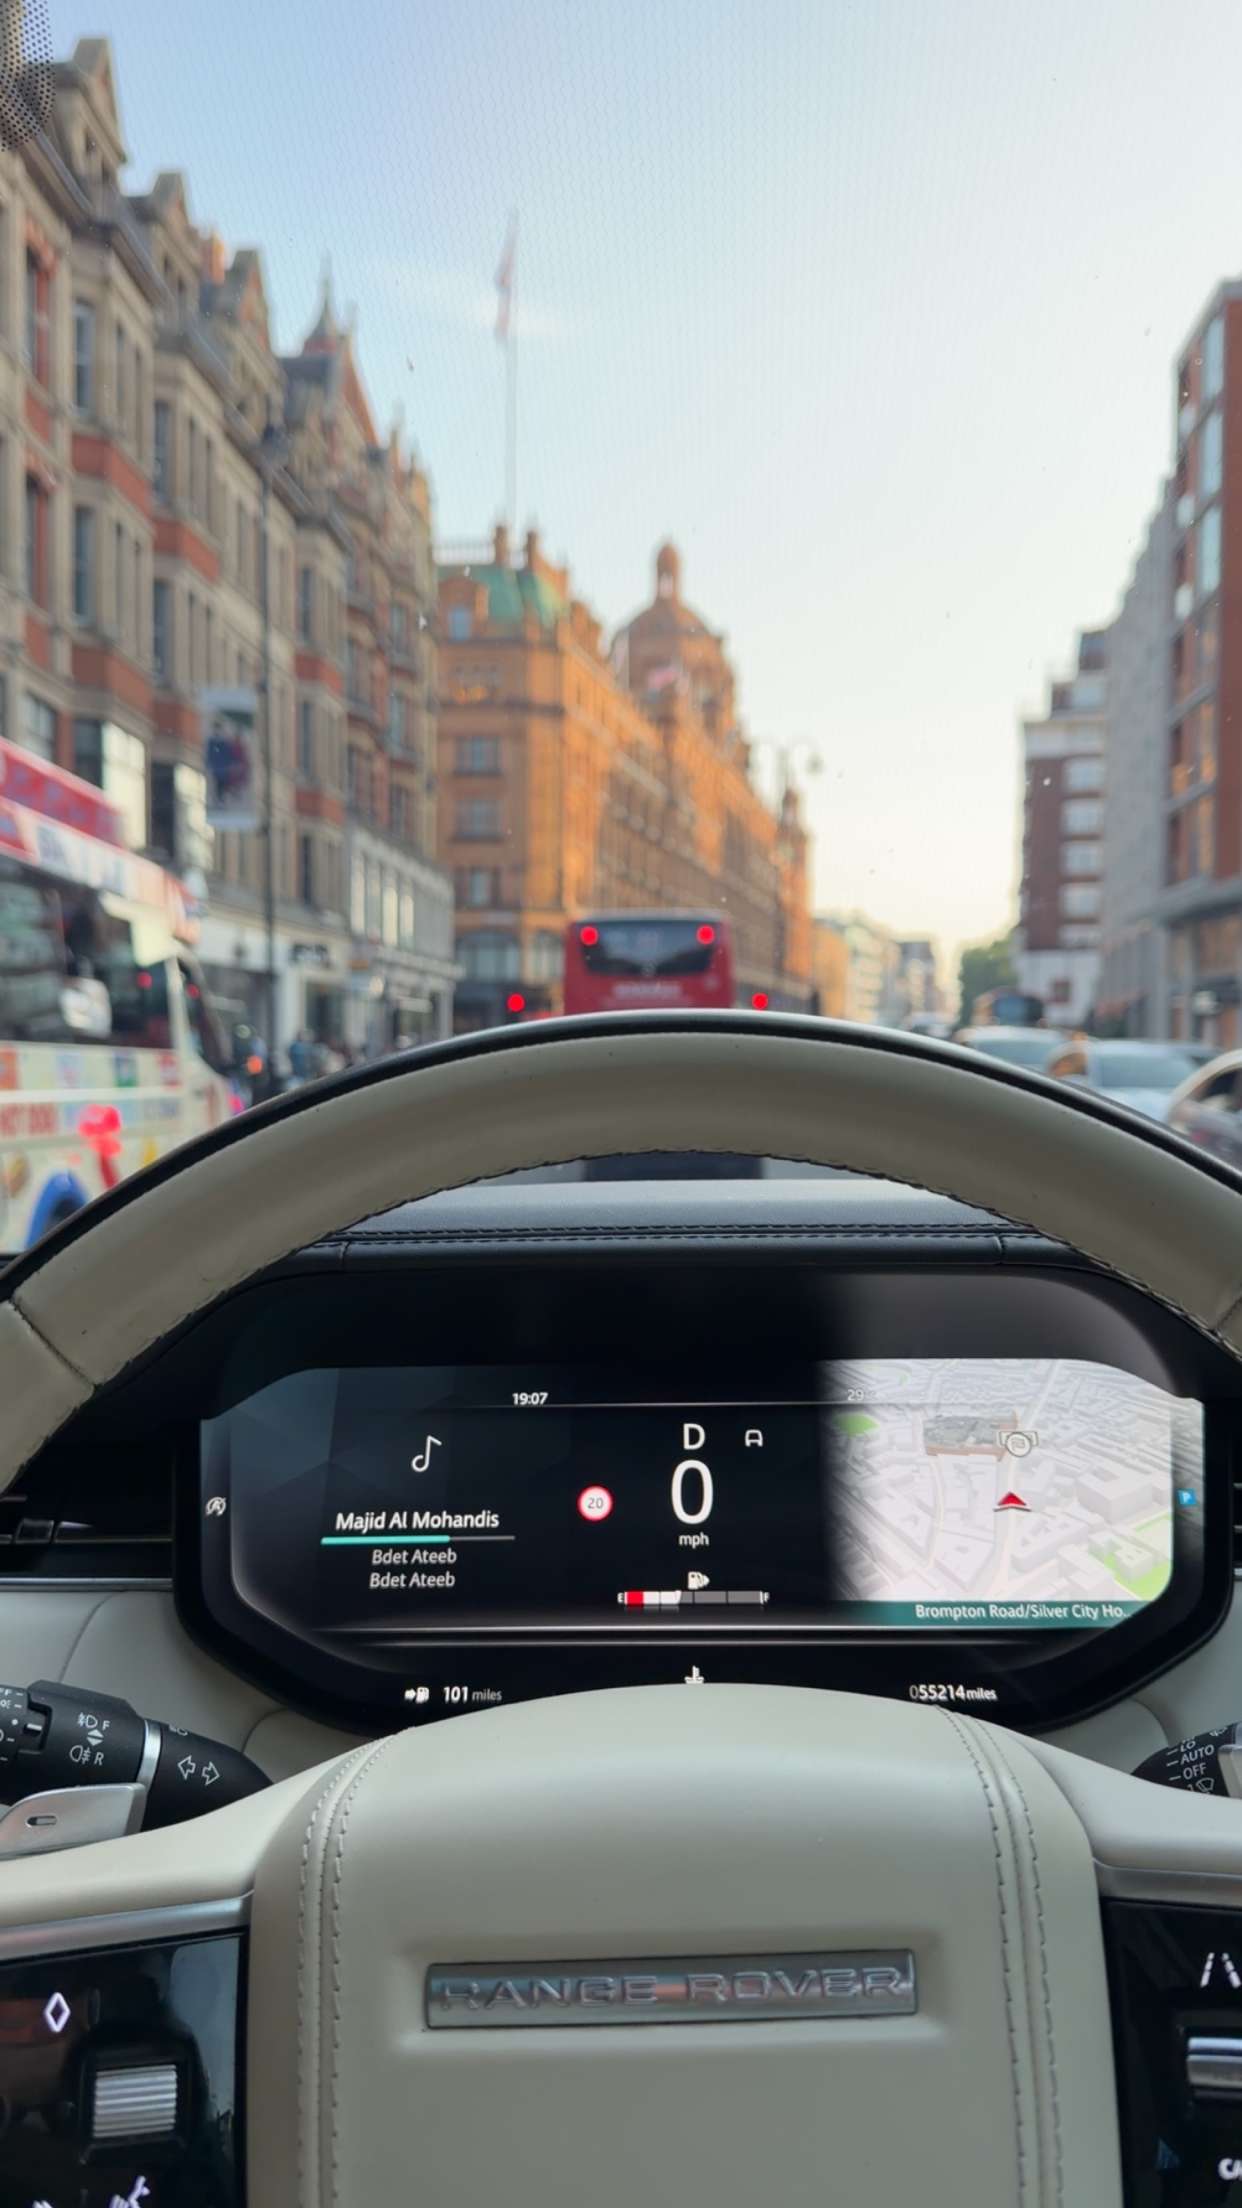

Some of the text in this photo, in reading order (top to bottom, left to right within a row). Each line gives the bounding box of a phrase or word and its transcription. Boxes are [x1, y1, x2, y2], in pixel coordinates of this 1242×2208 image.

[512, 1391, 549, 1406] 19:07
[683, 1423, 706, 1450] D
[671, 1459, 714, 1525] 0
[587, 1497, 604, 1510] 20
[335, 1509, 500, 1534] Majid Al Mohandis
[678, 1532, 710, 1549] mph
[371, 1547, 457, 1566] Bdet Ateeb
[369, 1570, 455, 1589] Bdet Ateeb
[915, 1604, 986, 1620] Brompton
[989, 1603, 1068, 1618] Road/Silver
[1071, 1604, 1099, 1621] City
[443, 1686, 502, 1703] 101 miles
[102, 1720, 110, 1730] F
[94, 1752, 104, 1766] R
[1180, 1744, 1215, 1765] AUTO
[1183, 1762, 1206, 1780] OFF
[441, 1967, 900, 2010] RANGE ROVER
